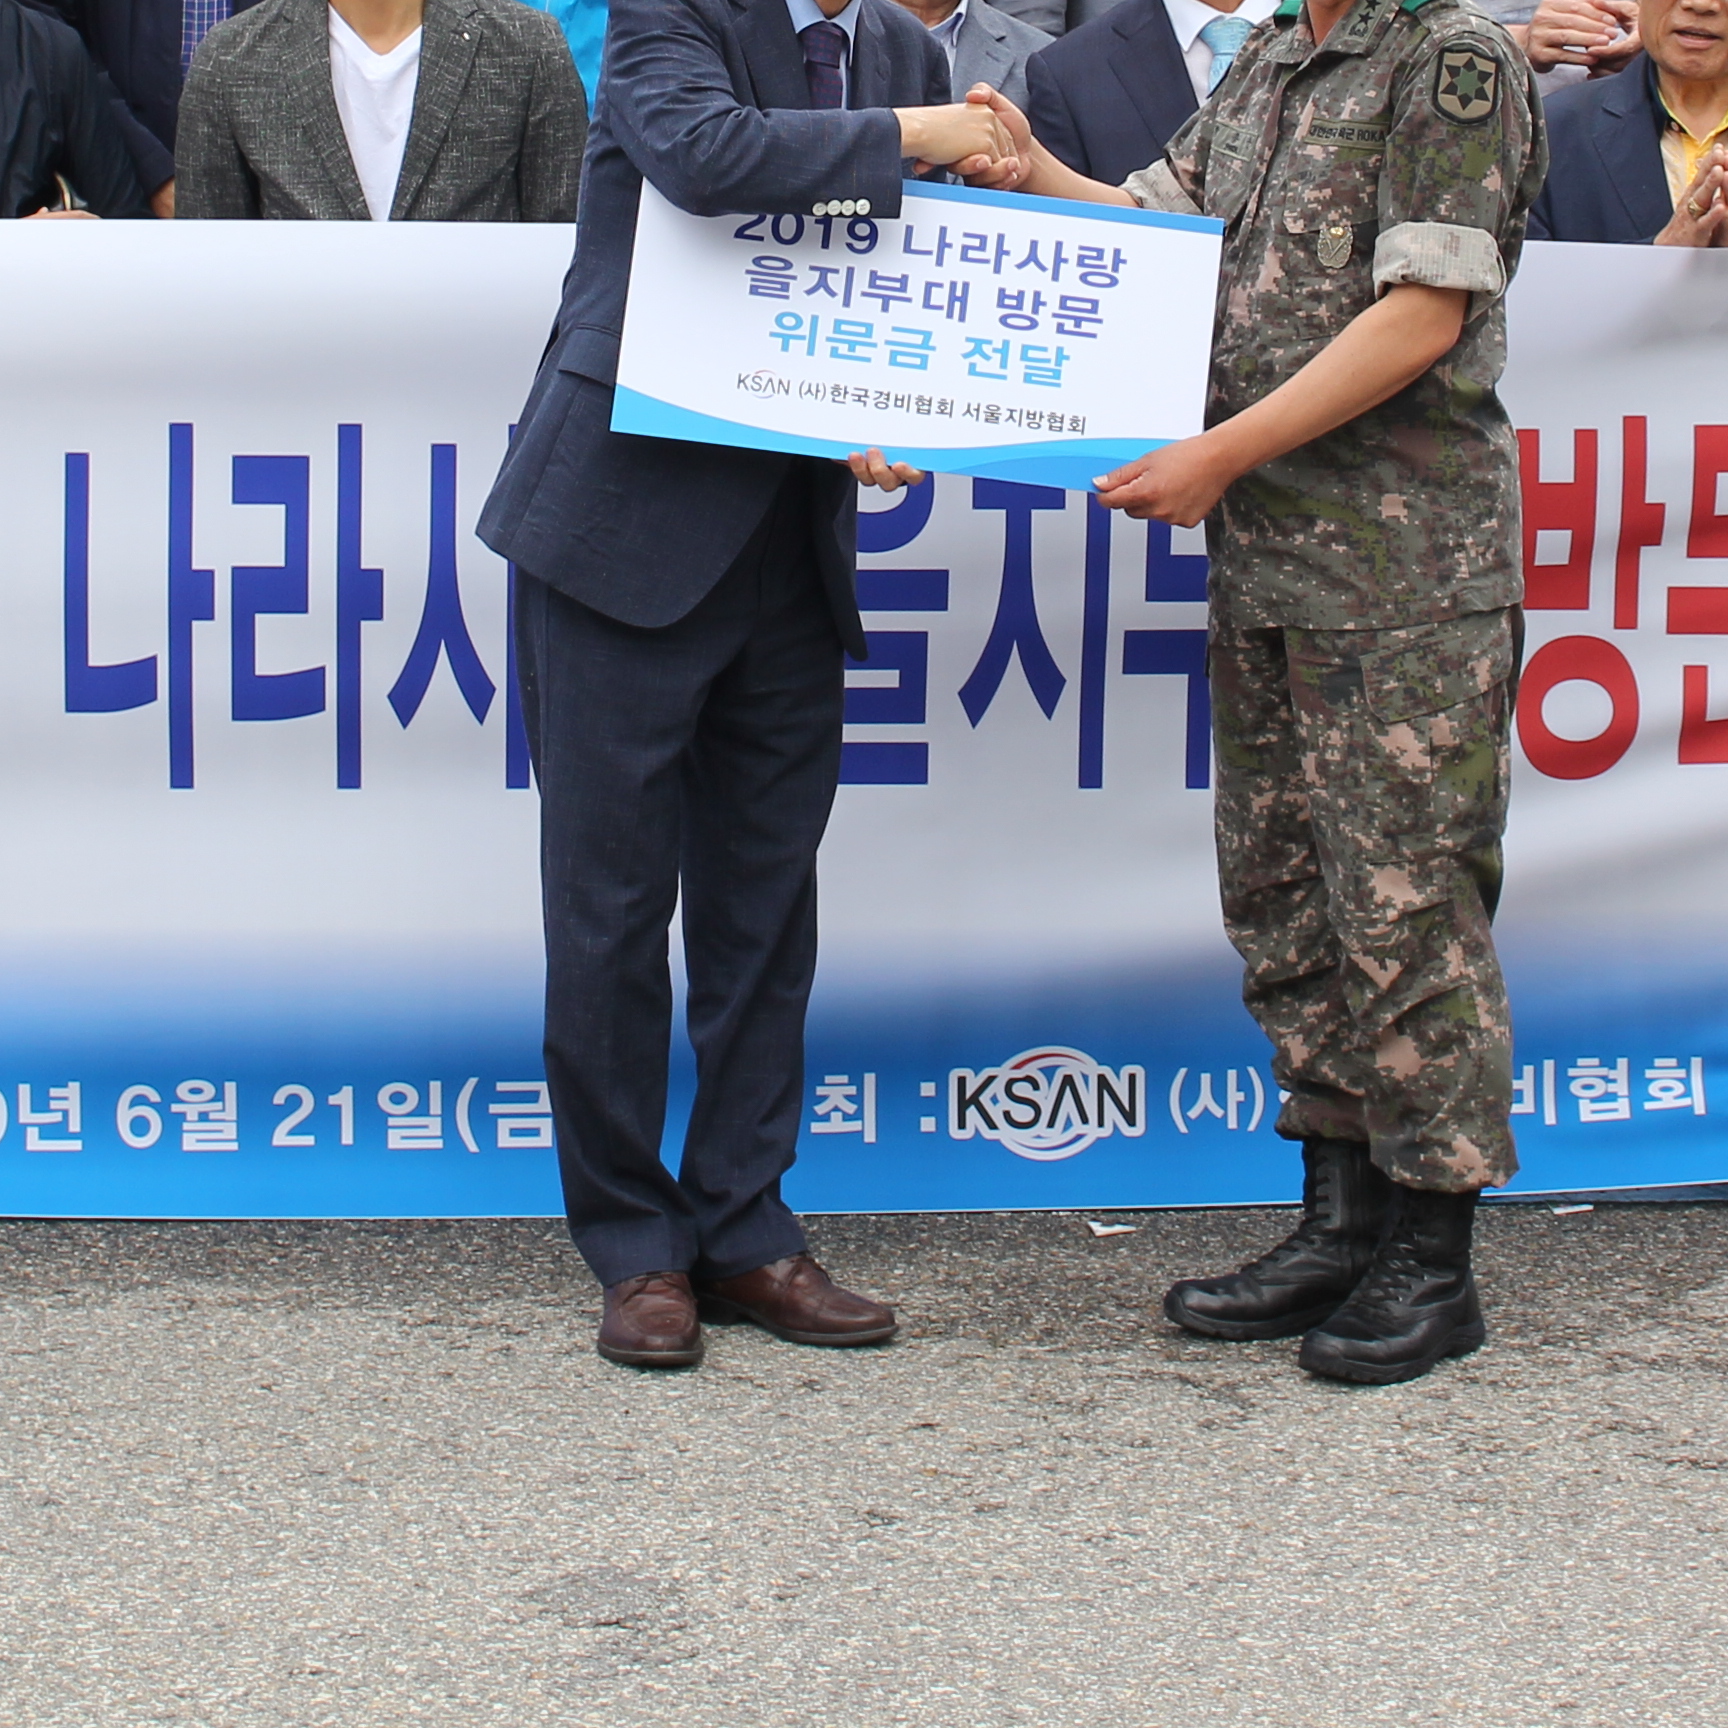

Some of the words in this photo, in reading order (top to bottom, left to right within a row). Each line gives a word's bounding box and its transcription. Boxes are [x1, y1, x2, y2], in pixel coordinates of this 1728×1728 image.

[1357, 128, 1385, 143] ROKA
[733, 214, 880, 255] 2019
[902, 224, 1128, 289] 나라사랑
[744, 255, 971, 323] 을지부대
[996, 287, 1104, 339] 방문
[769, 311, 936, 371] 위문금
[960, 335, 1071, 388] 전달
[737, 371, 790, 397] KSAN
[962, 402, 1087, 435] 서울지방협회
[65, 422, 530, 789] 나라사
[116, 1079, 238, 1151] 6월
[271, 1077, 553, 1153] 21일(금
[955, 1069, 1139, 1133] KSAN
